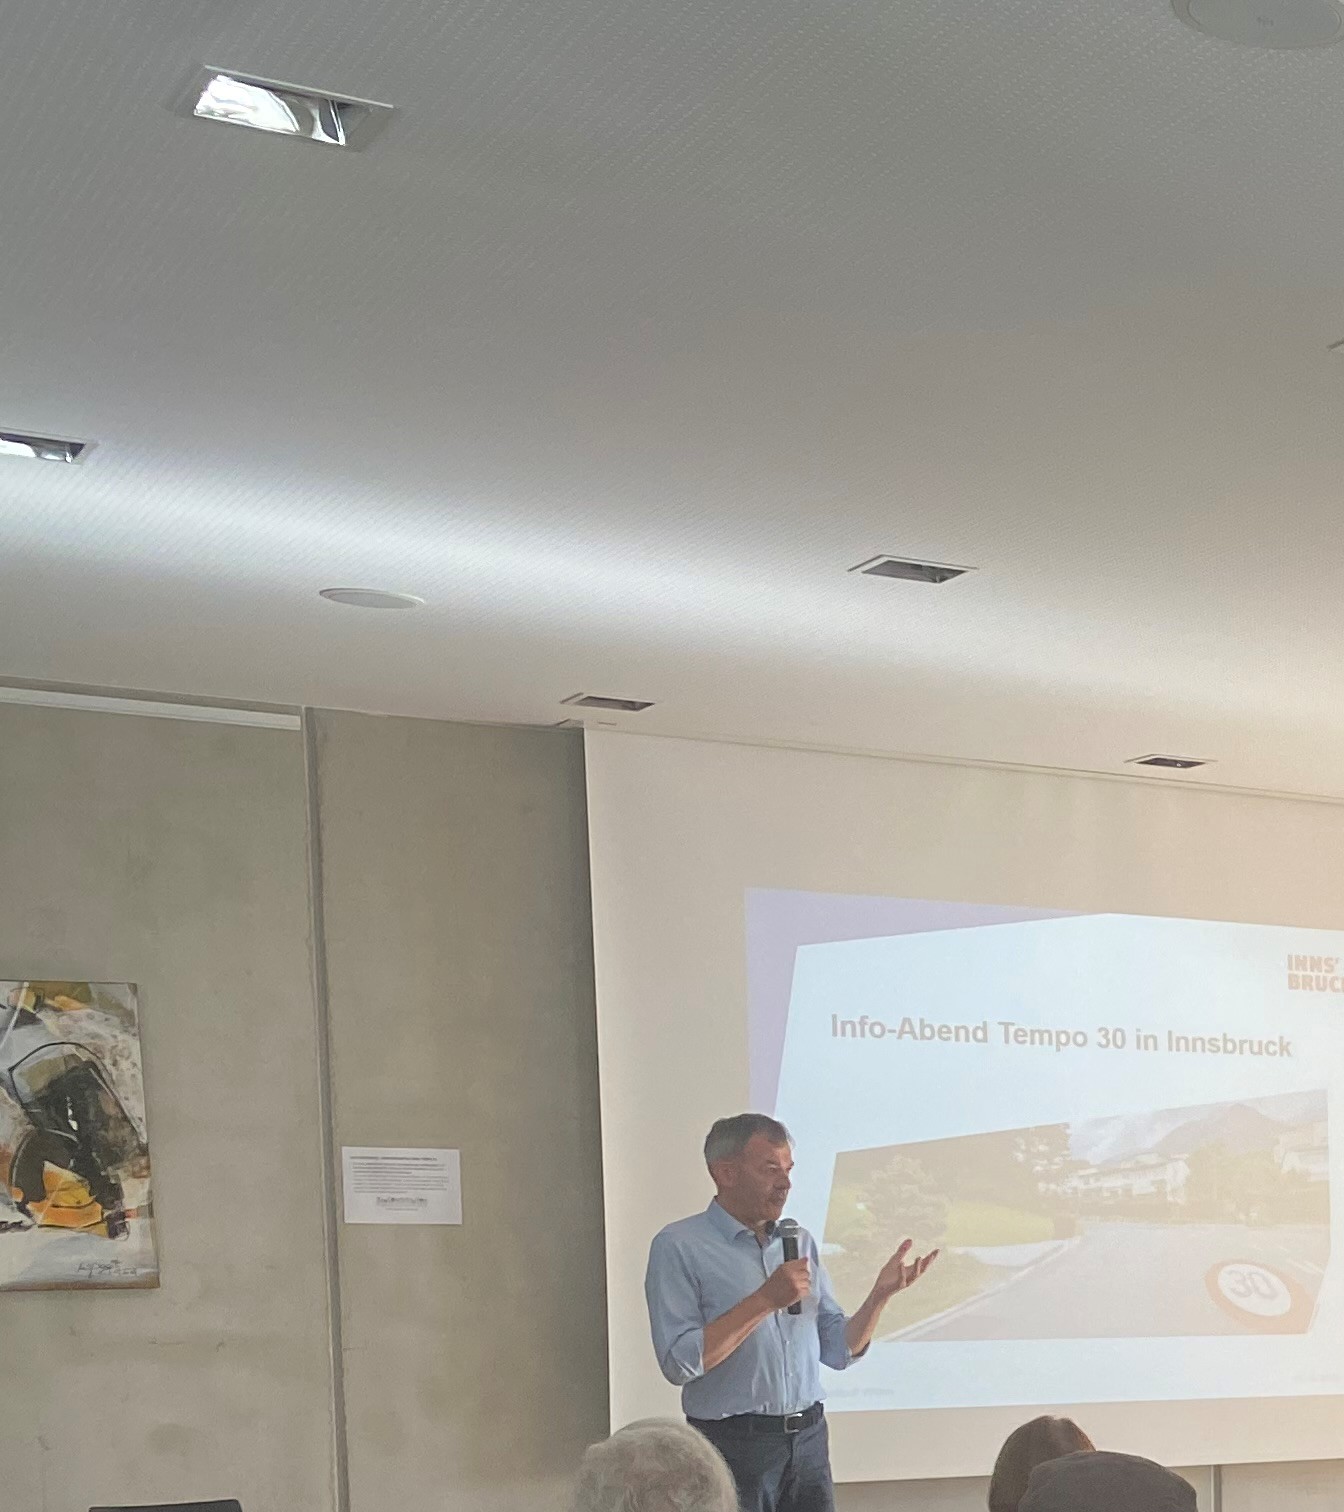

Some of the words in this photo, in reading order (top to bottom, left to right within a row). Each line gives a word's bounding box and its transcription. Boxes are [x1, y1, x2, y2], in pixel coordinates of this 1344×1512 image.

[831, 1013, 988, 1043] Info-Abend
[997, 1021, 1088, 1052] Tempo
[1096, 1026, 1127, 1050] 30
[1135, 1027, 1159, 1051] in
[1167, 1029, 1294, 1058] Innsbruck
[1225, 1269, 1280, 1301] 30
